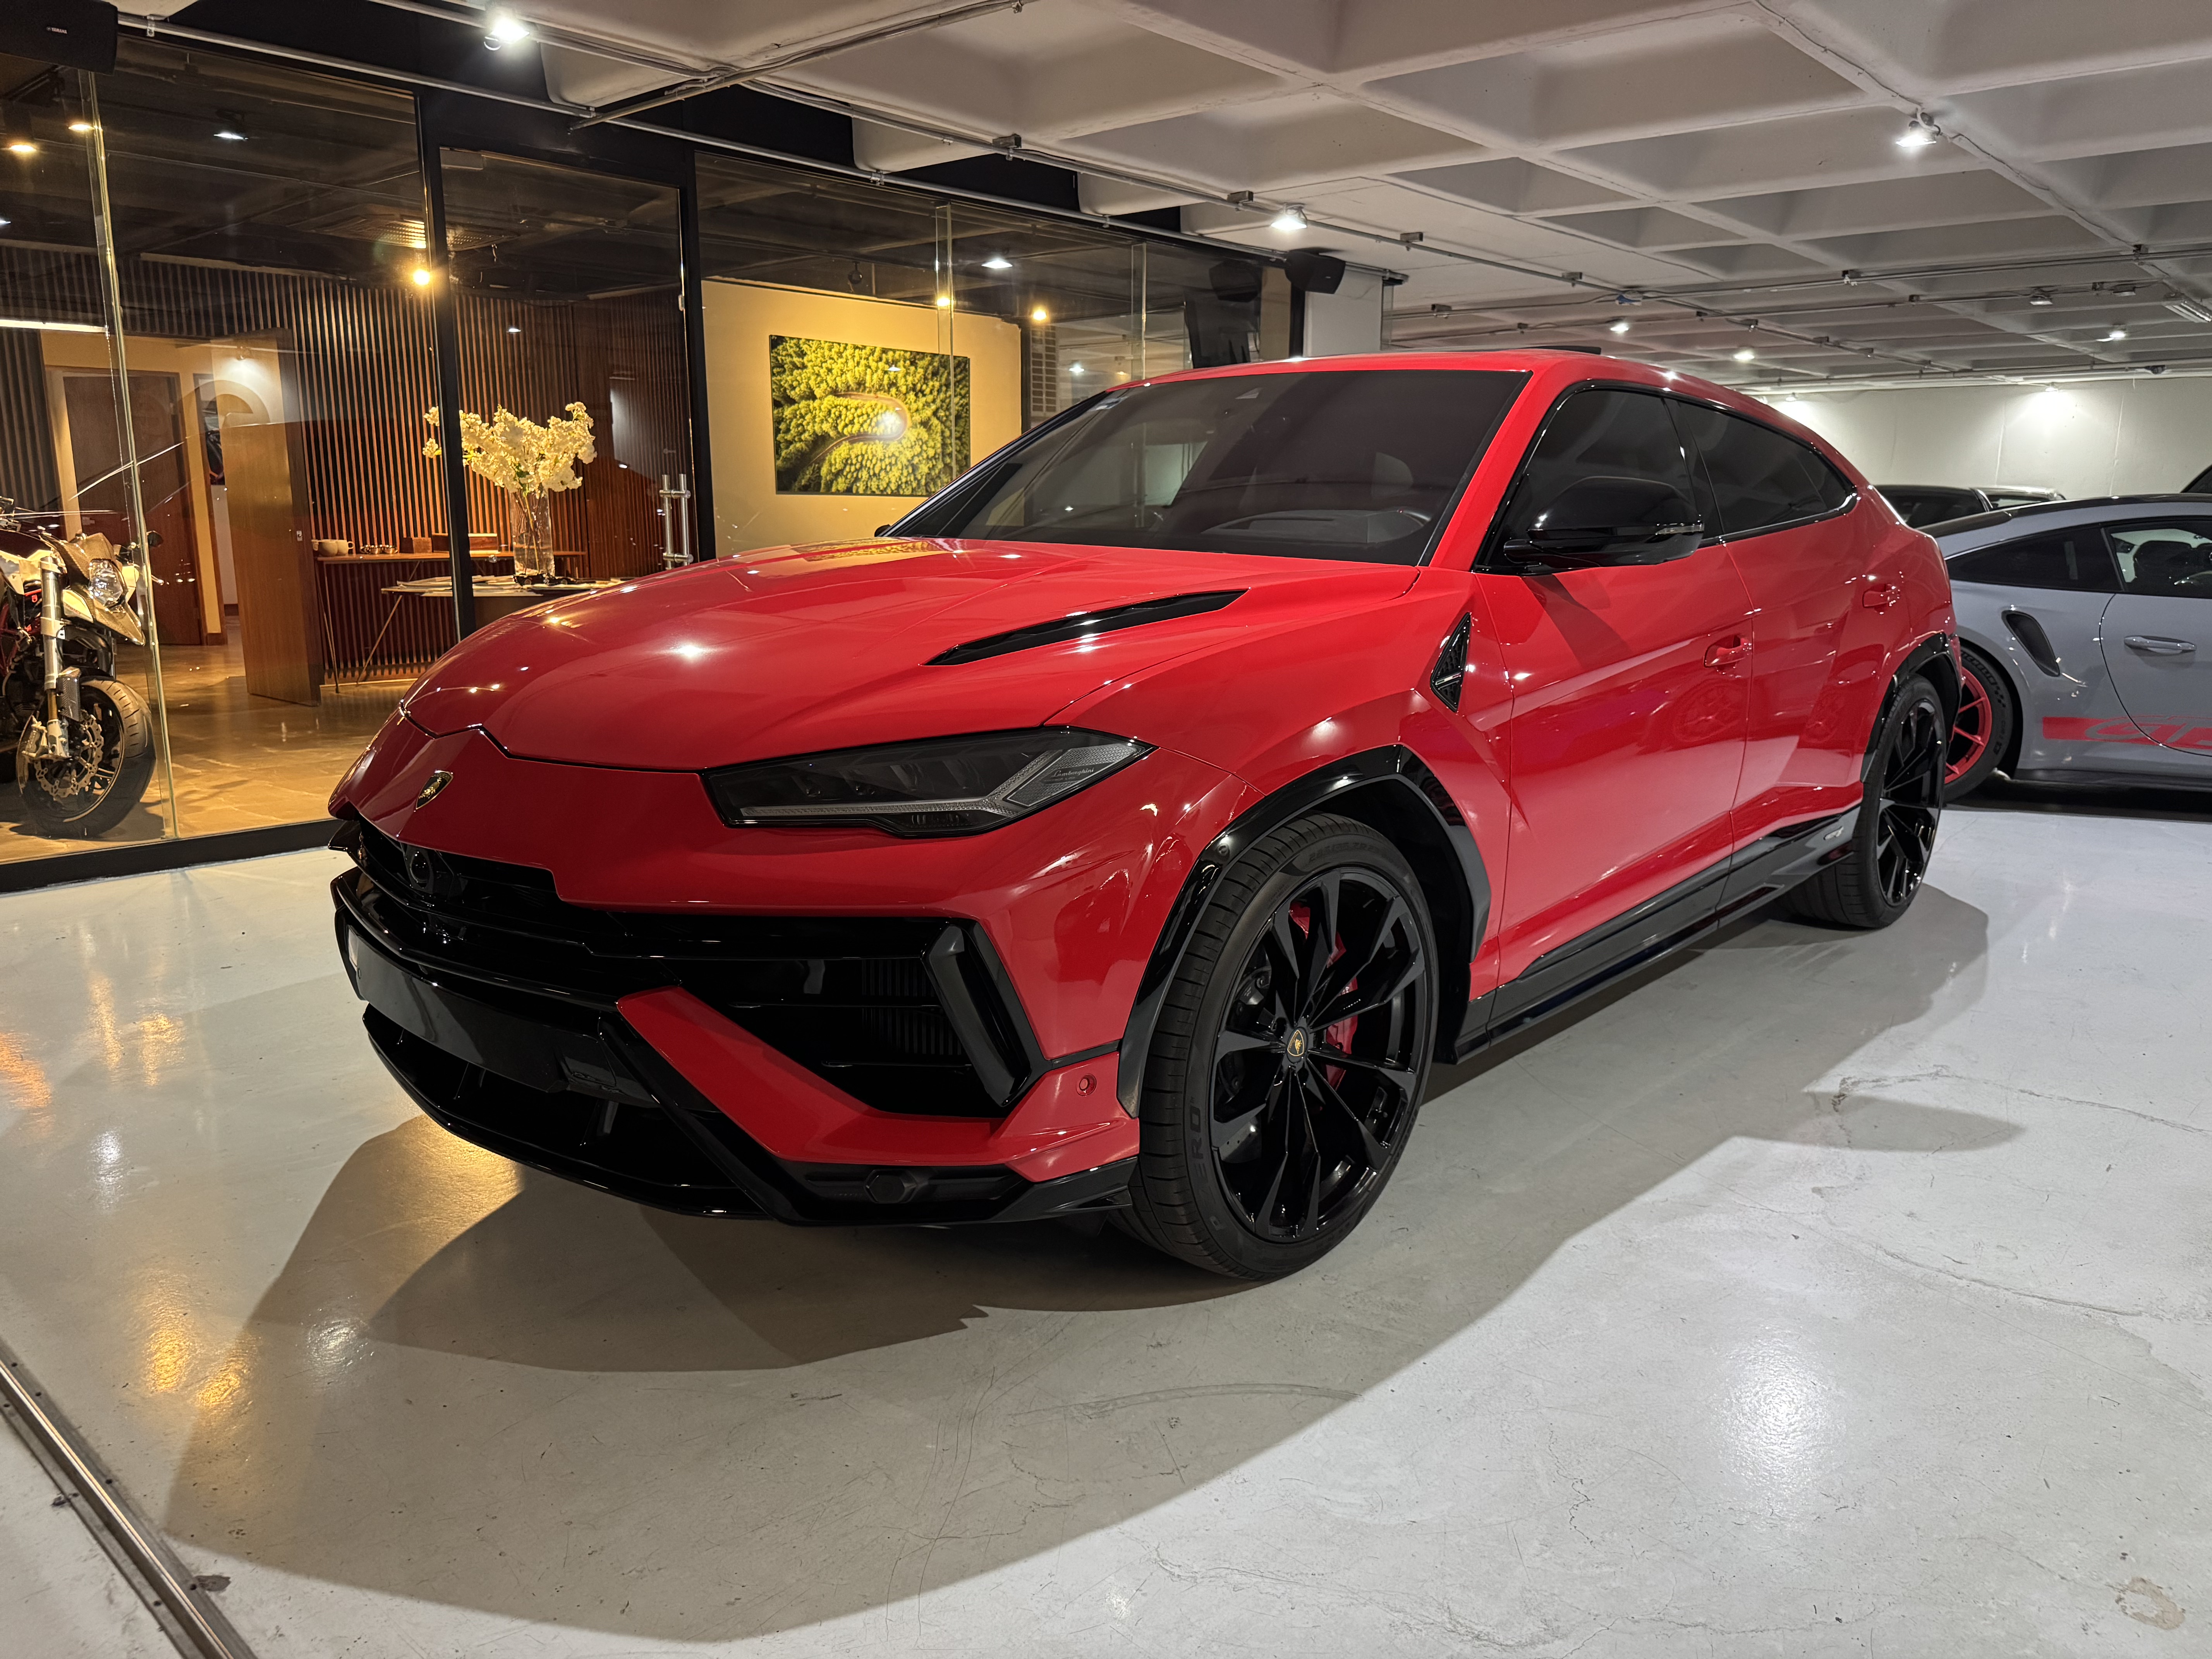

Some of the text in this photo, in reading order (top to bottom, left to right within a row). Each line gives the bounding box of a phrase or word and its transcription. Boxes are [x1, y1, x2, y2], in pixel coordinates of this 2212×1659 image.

[1960, 651, 1997, 685] ICHELIN
[2085, 716, 2212, 746] GT
[1052, 768, 1094, 777] Lamborghini
[1190, 1106, 1216, 1204] ZERO
